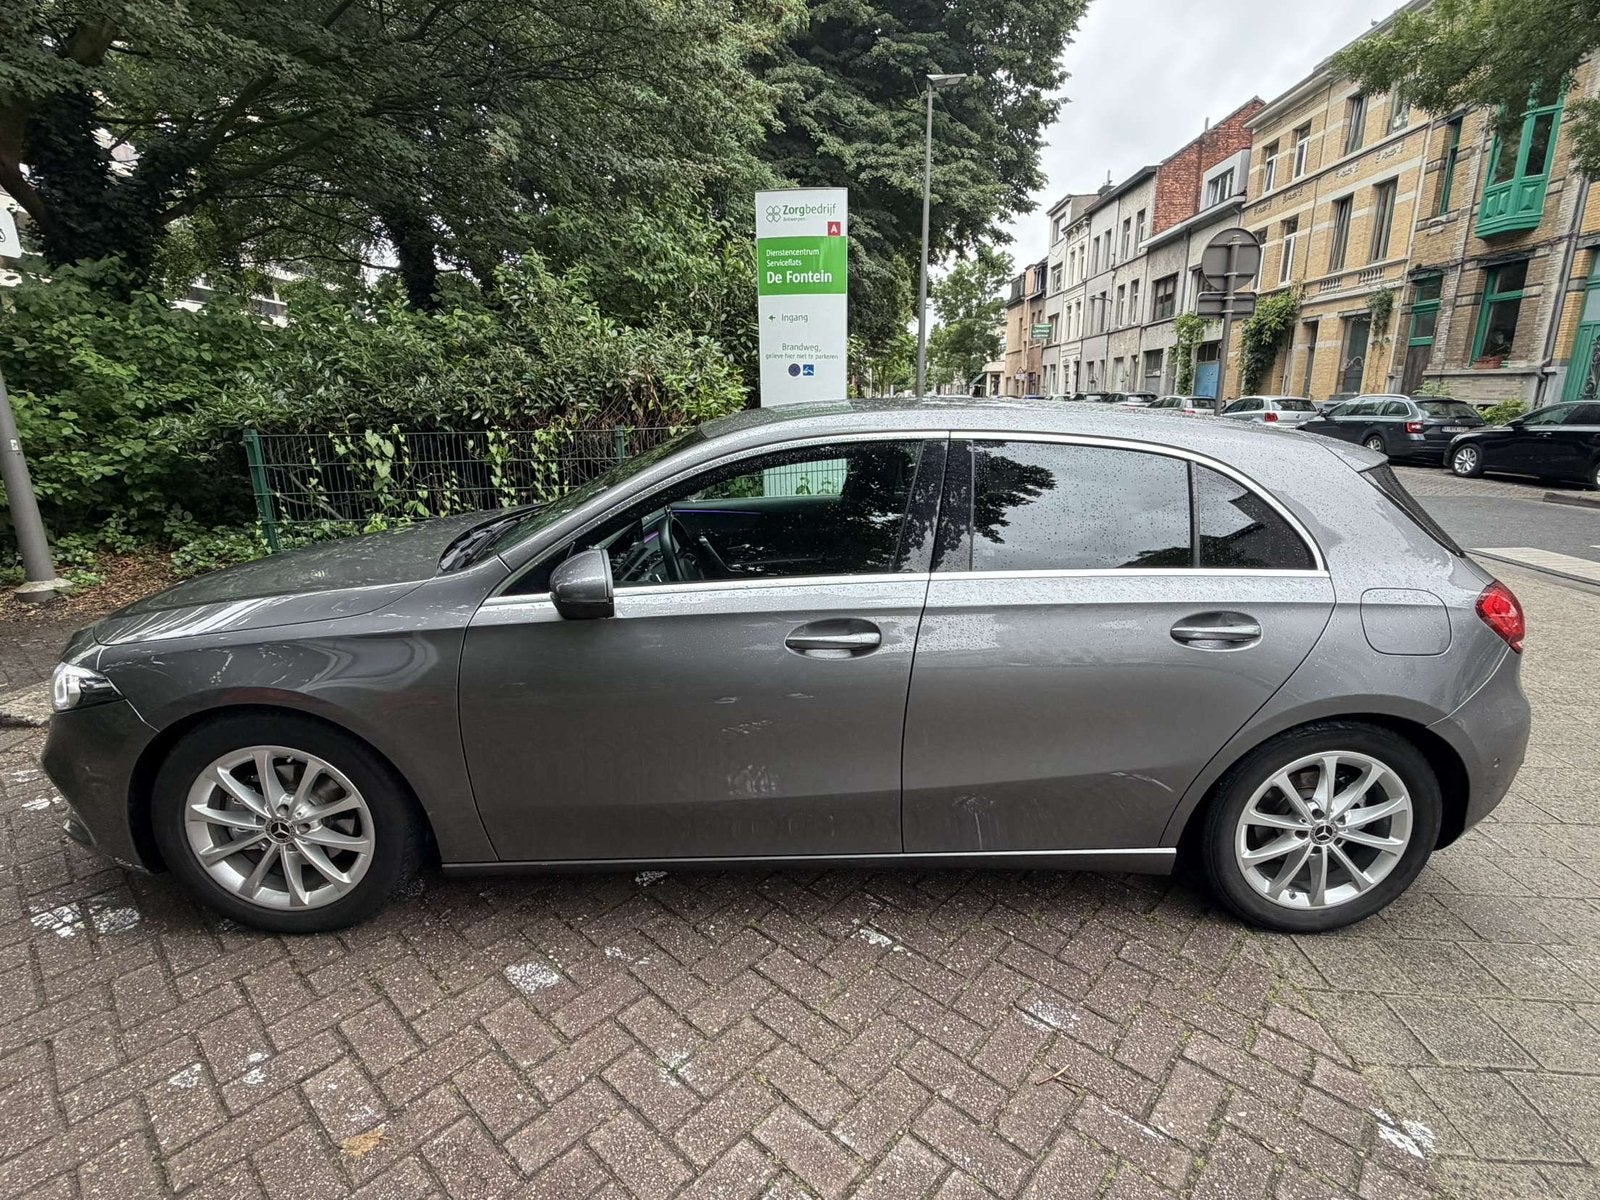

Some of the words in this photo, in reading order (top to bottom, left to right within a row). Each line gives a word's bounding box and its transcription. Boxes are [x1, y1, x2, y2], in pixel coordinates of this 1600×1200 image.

[782, 203, 836, 216] Zorgbedrijf
[830, 224, 838, 233] A
[766, 248, 820, 256] Dienstencentrum
[766, 259, 802, 267] Serviceflats
[767, 271, 782, 283] De
[786, 270, 832, 283] Fontein
[781, 313, 808, 323] Ingang
[782, 343, 821, 352] Brandweg,
